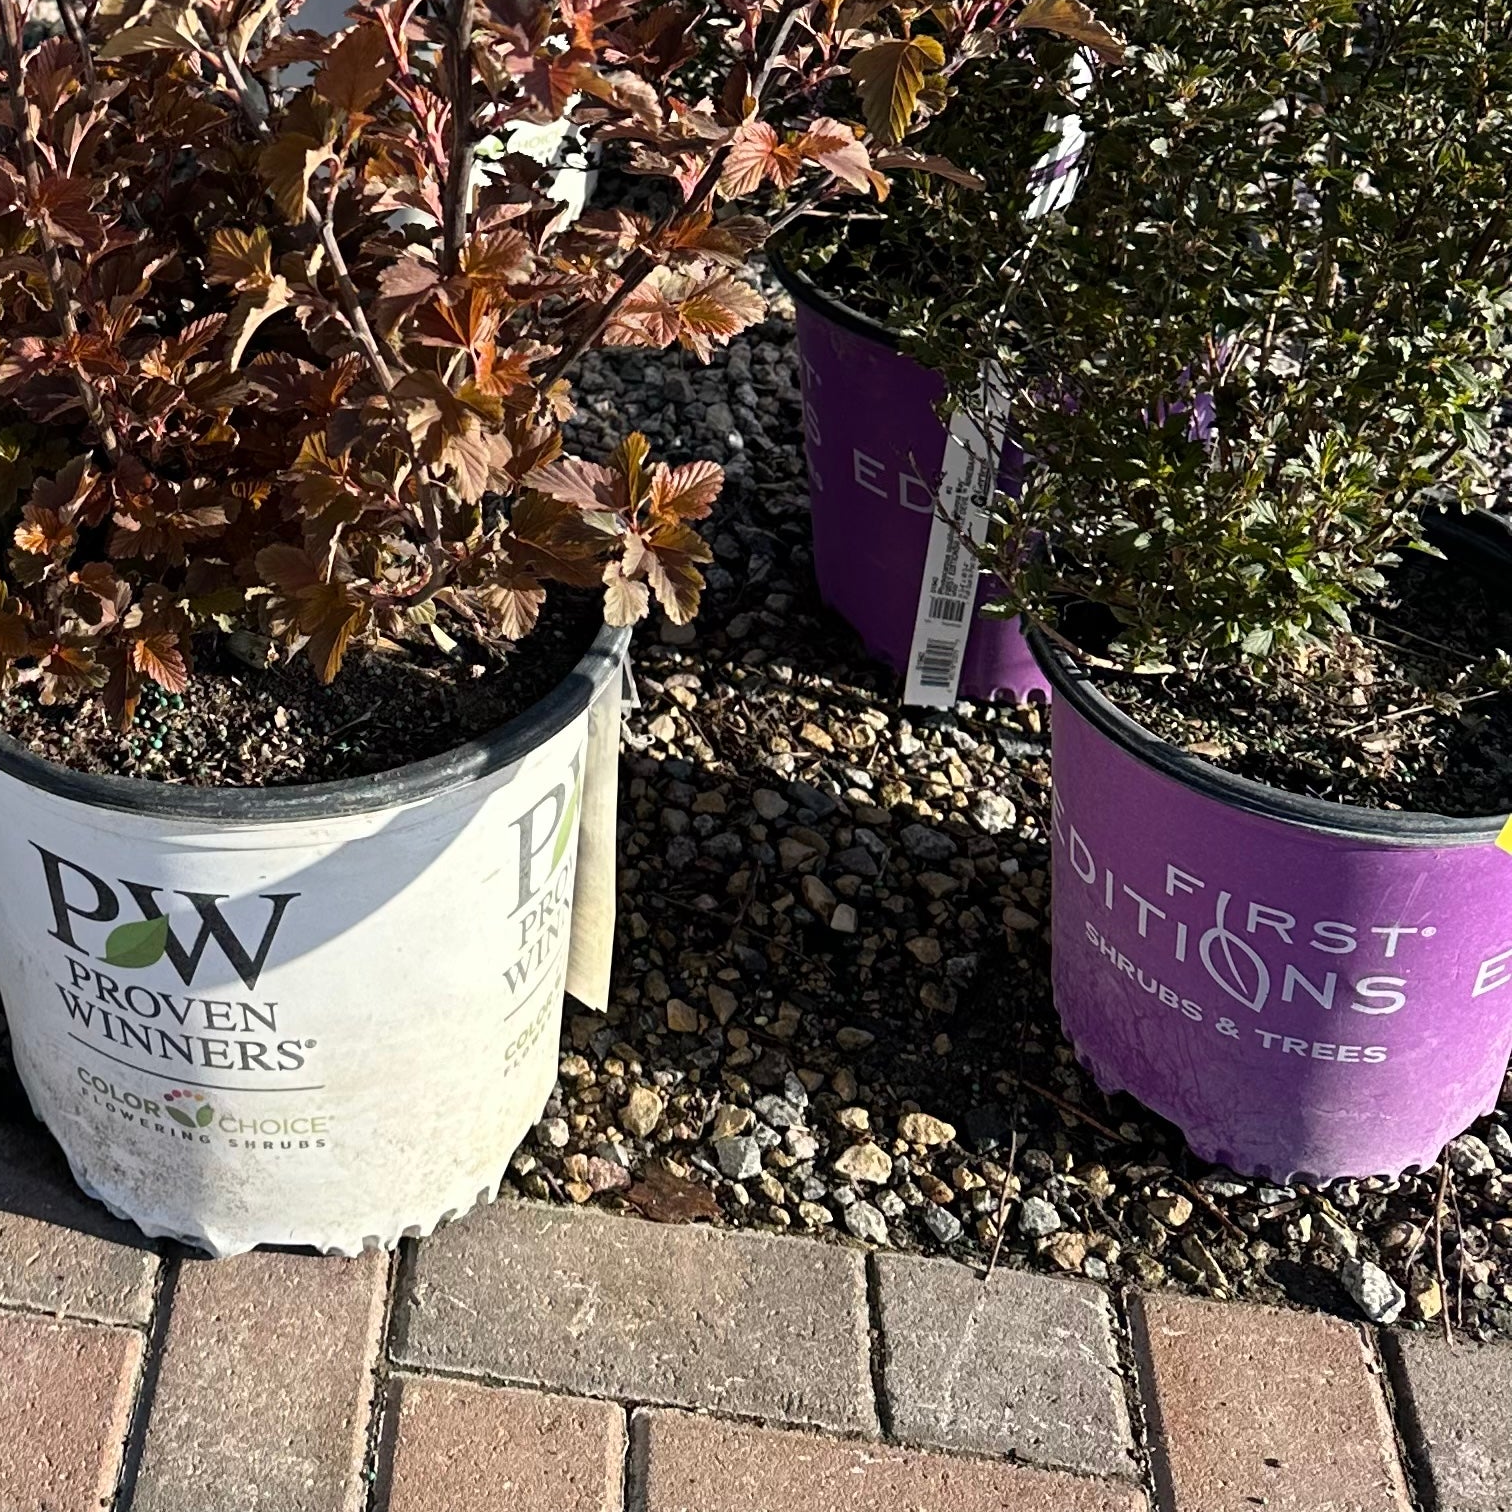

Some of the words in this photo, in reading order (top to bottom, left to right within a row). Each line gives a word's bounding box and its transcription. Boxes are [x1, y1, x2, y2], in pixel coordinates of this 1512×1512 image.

[28, 839, 301, 991] PW
[64, 954, 278, 1034] PROVEN
[1085, 920, 1203, 1023] SHRUBS
[1215, 1017, 1241, 1040] &
[1254, 1028, 1388, 1064] TREES
[77, 1065, 162, 1119] COLOR
[219, 1116, 330, 1135] CHOICE
[81, 1086, 212, 1145] FLOWERING
[228, 1138, 327, 1150] SHRUBS
